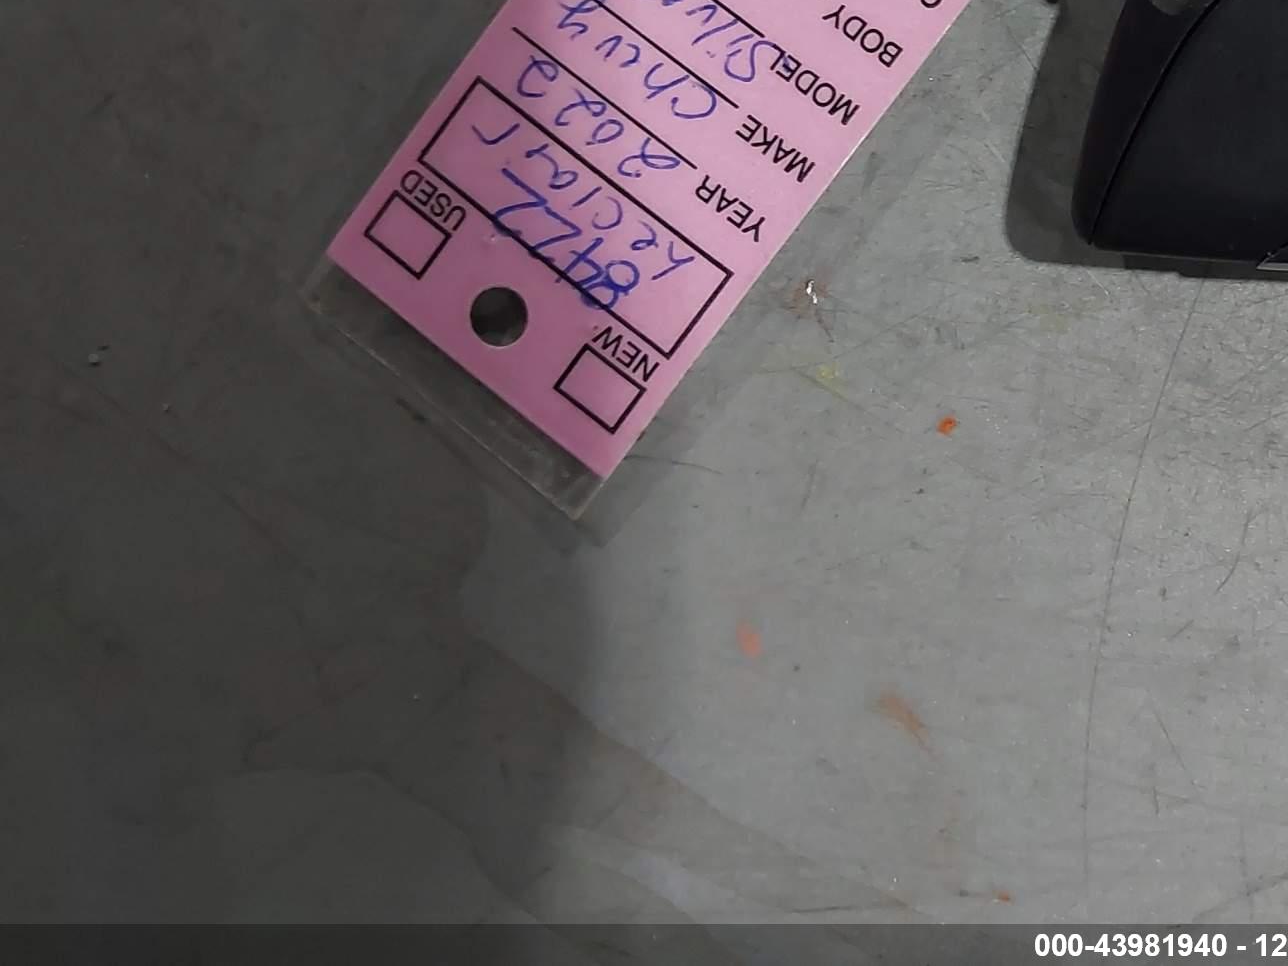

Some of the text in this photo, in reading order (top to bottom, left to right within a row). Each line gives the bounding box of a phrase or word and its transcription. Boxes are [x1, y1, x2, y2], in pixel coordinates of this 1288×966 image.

[822, 4, 903, 68] BODY
[516, 55, 681, 178] 2022
[768, 43, 860, 125] MODEL
[735, 114, 816, 183] MAKE
[401, 169, 467, 231] USED
[694, 174, 766, 242] YEAR
[492, 167, 640, 310] 8422
[592, 326, 660, 383] NEW
